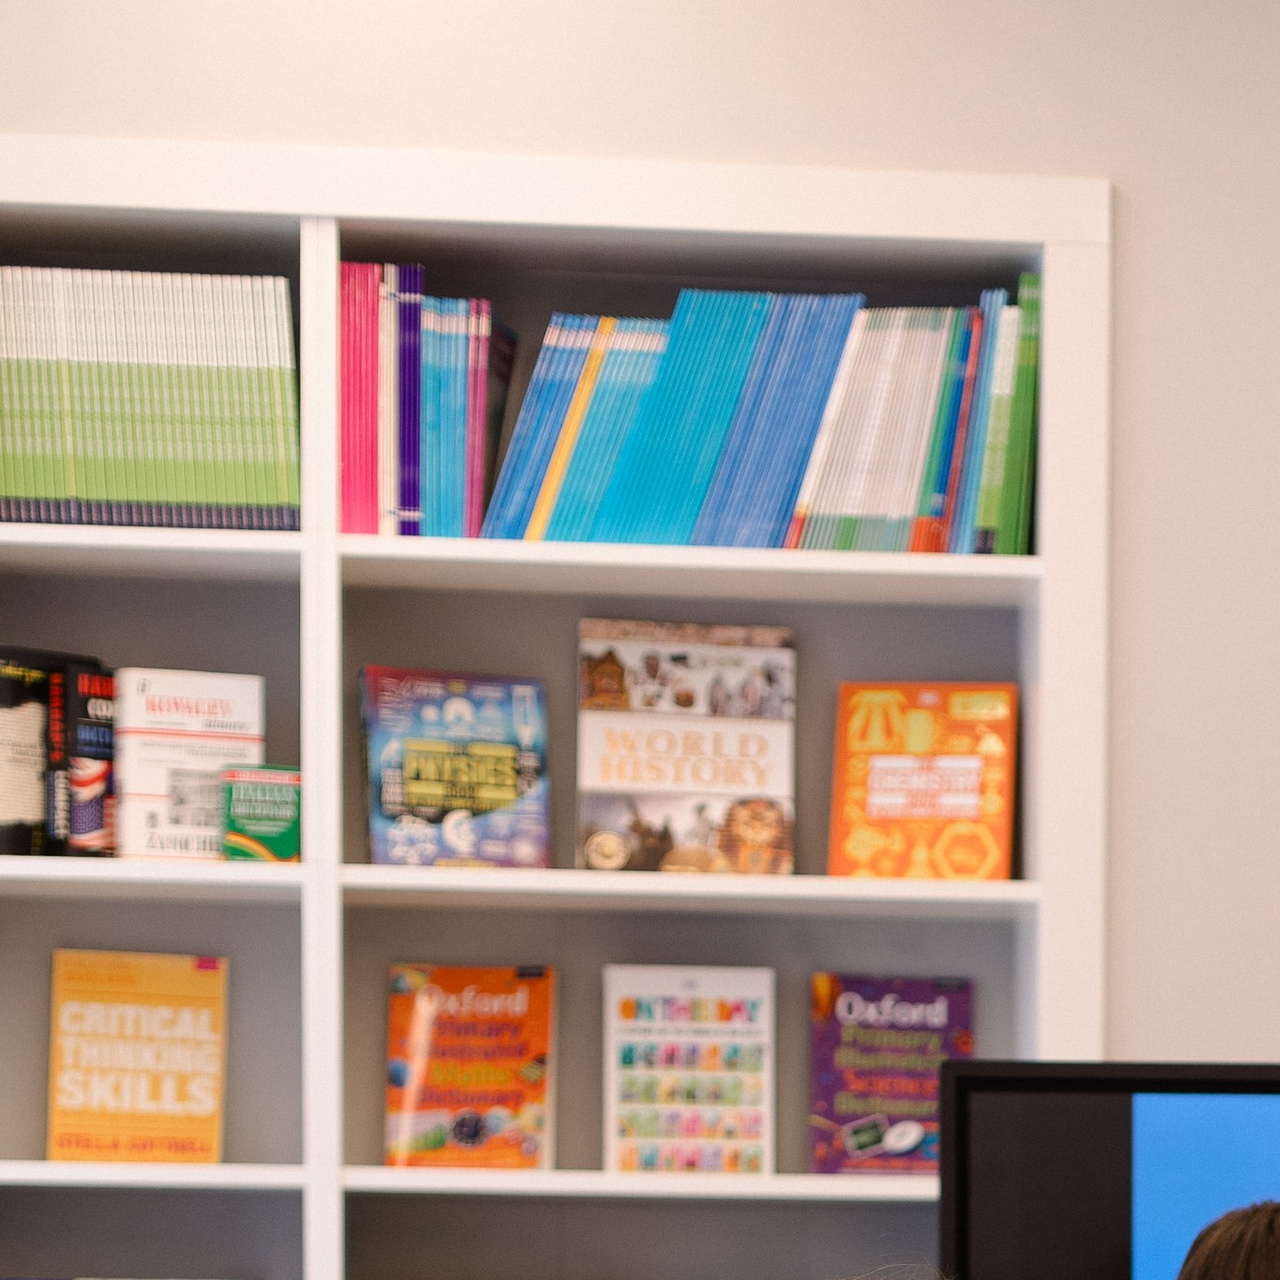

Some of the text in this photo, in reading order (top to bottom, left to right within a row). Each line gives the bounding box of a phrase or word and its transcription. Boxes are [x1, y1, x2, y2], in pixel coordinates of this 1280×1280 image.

[602, 726, 771, 759] WORLD
[600, 754, 774, 787] HISTORY
[834, 991, 949, 1028] Oxford
[57, 1069, 217, 1116] SKILLS
